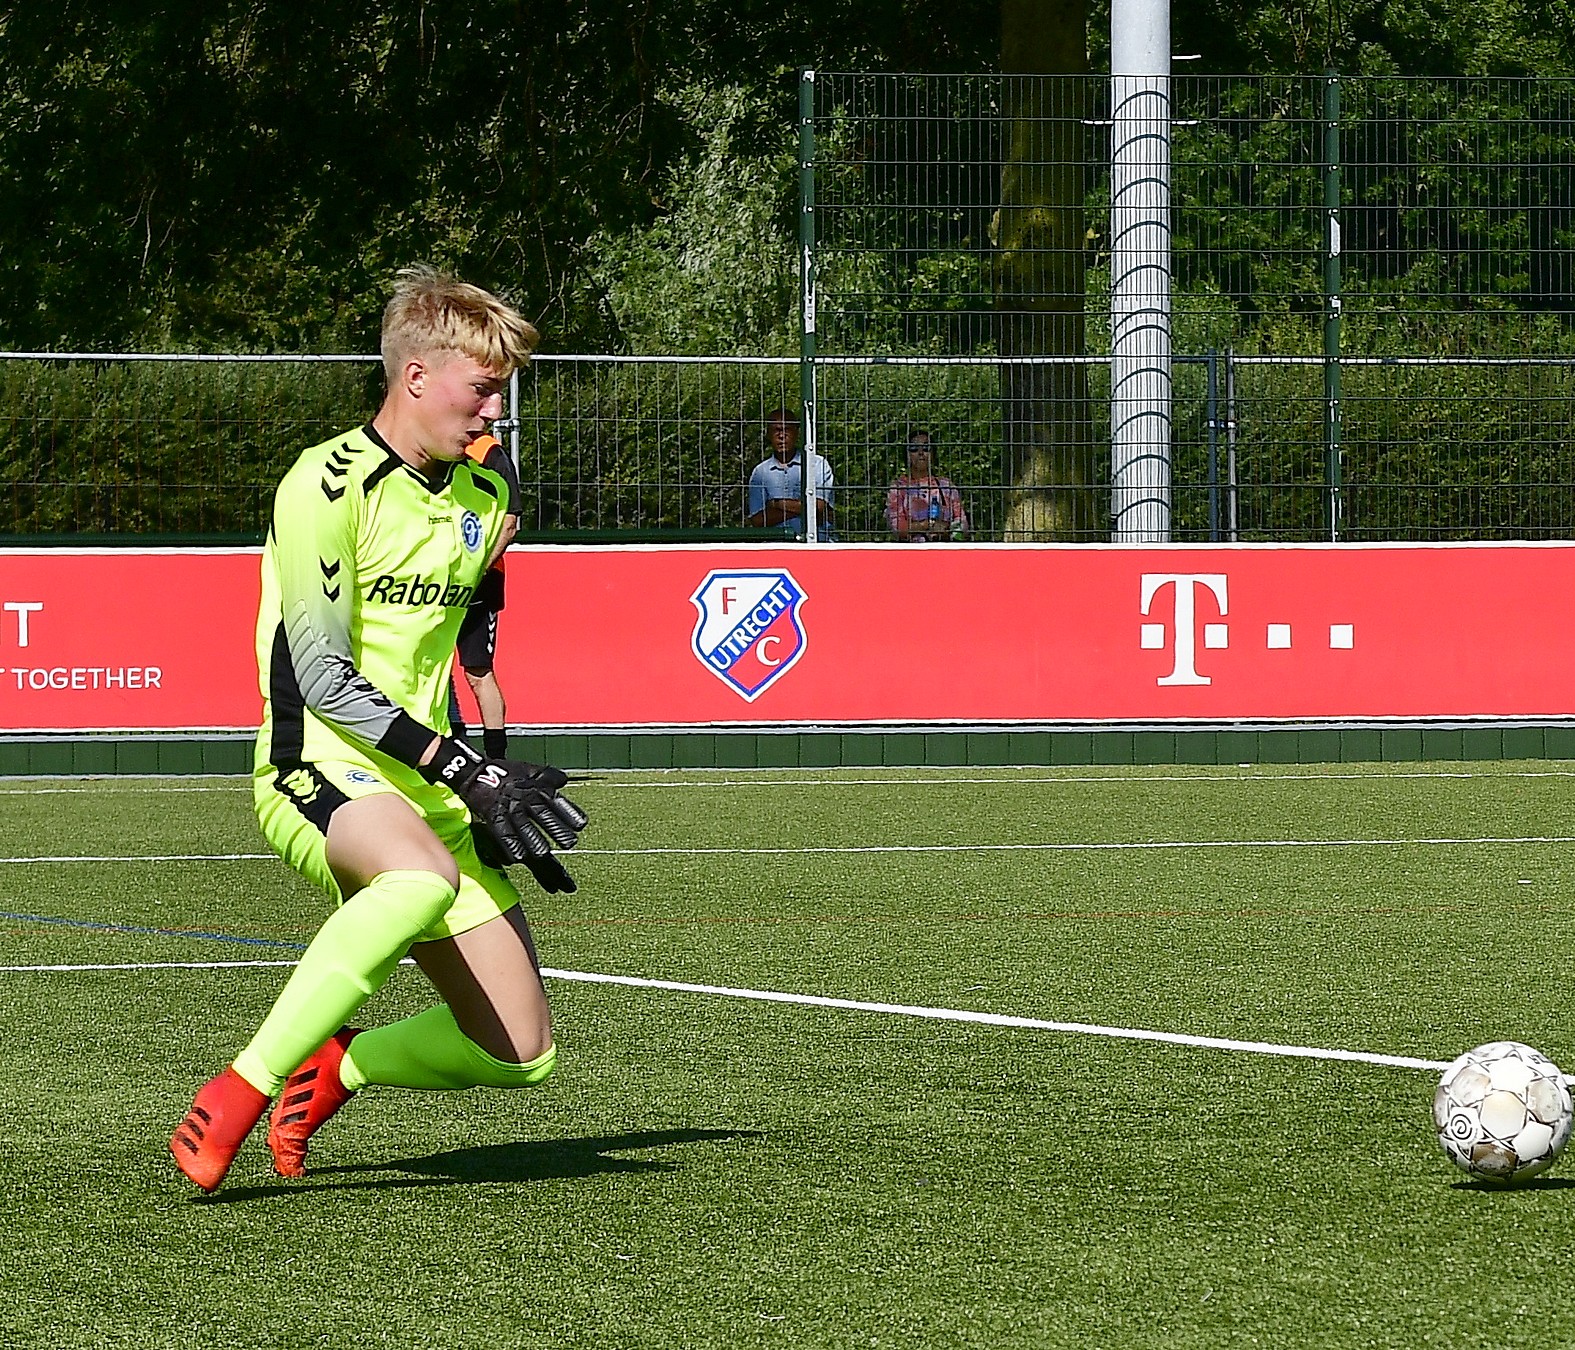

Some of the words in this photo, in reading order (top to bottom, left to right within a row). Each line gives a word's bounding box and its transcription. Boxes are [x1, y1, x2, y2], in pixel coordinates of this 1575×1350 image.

[365, 574, 477, 609] Raboban
[722, 587, 737, 615] F
[708, 581, 793, 671] UTRECHT
[755, 635, 781, 667] C
[11, 667, 162, 690] TOGETHER
